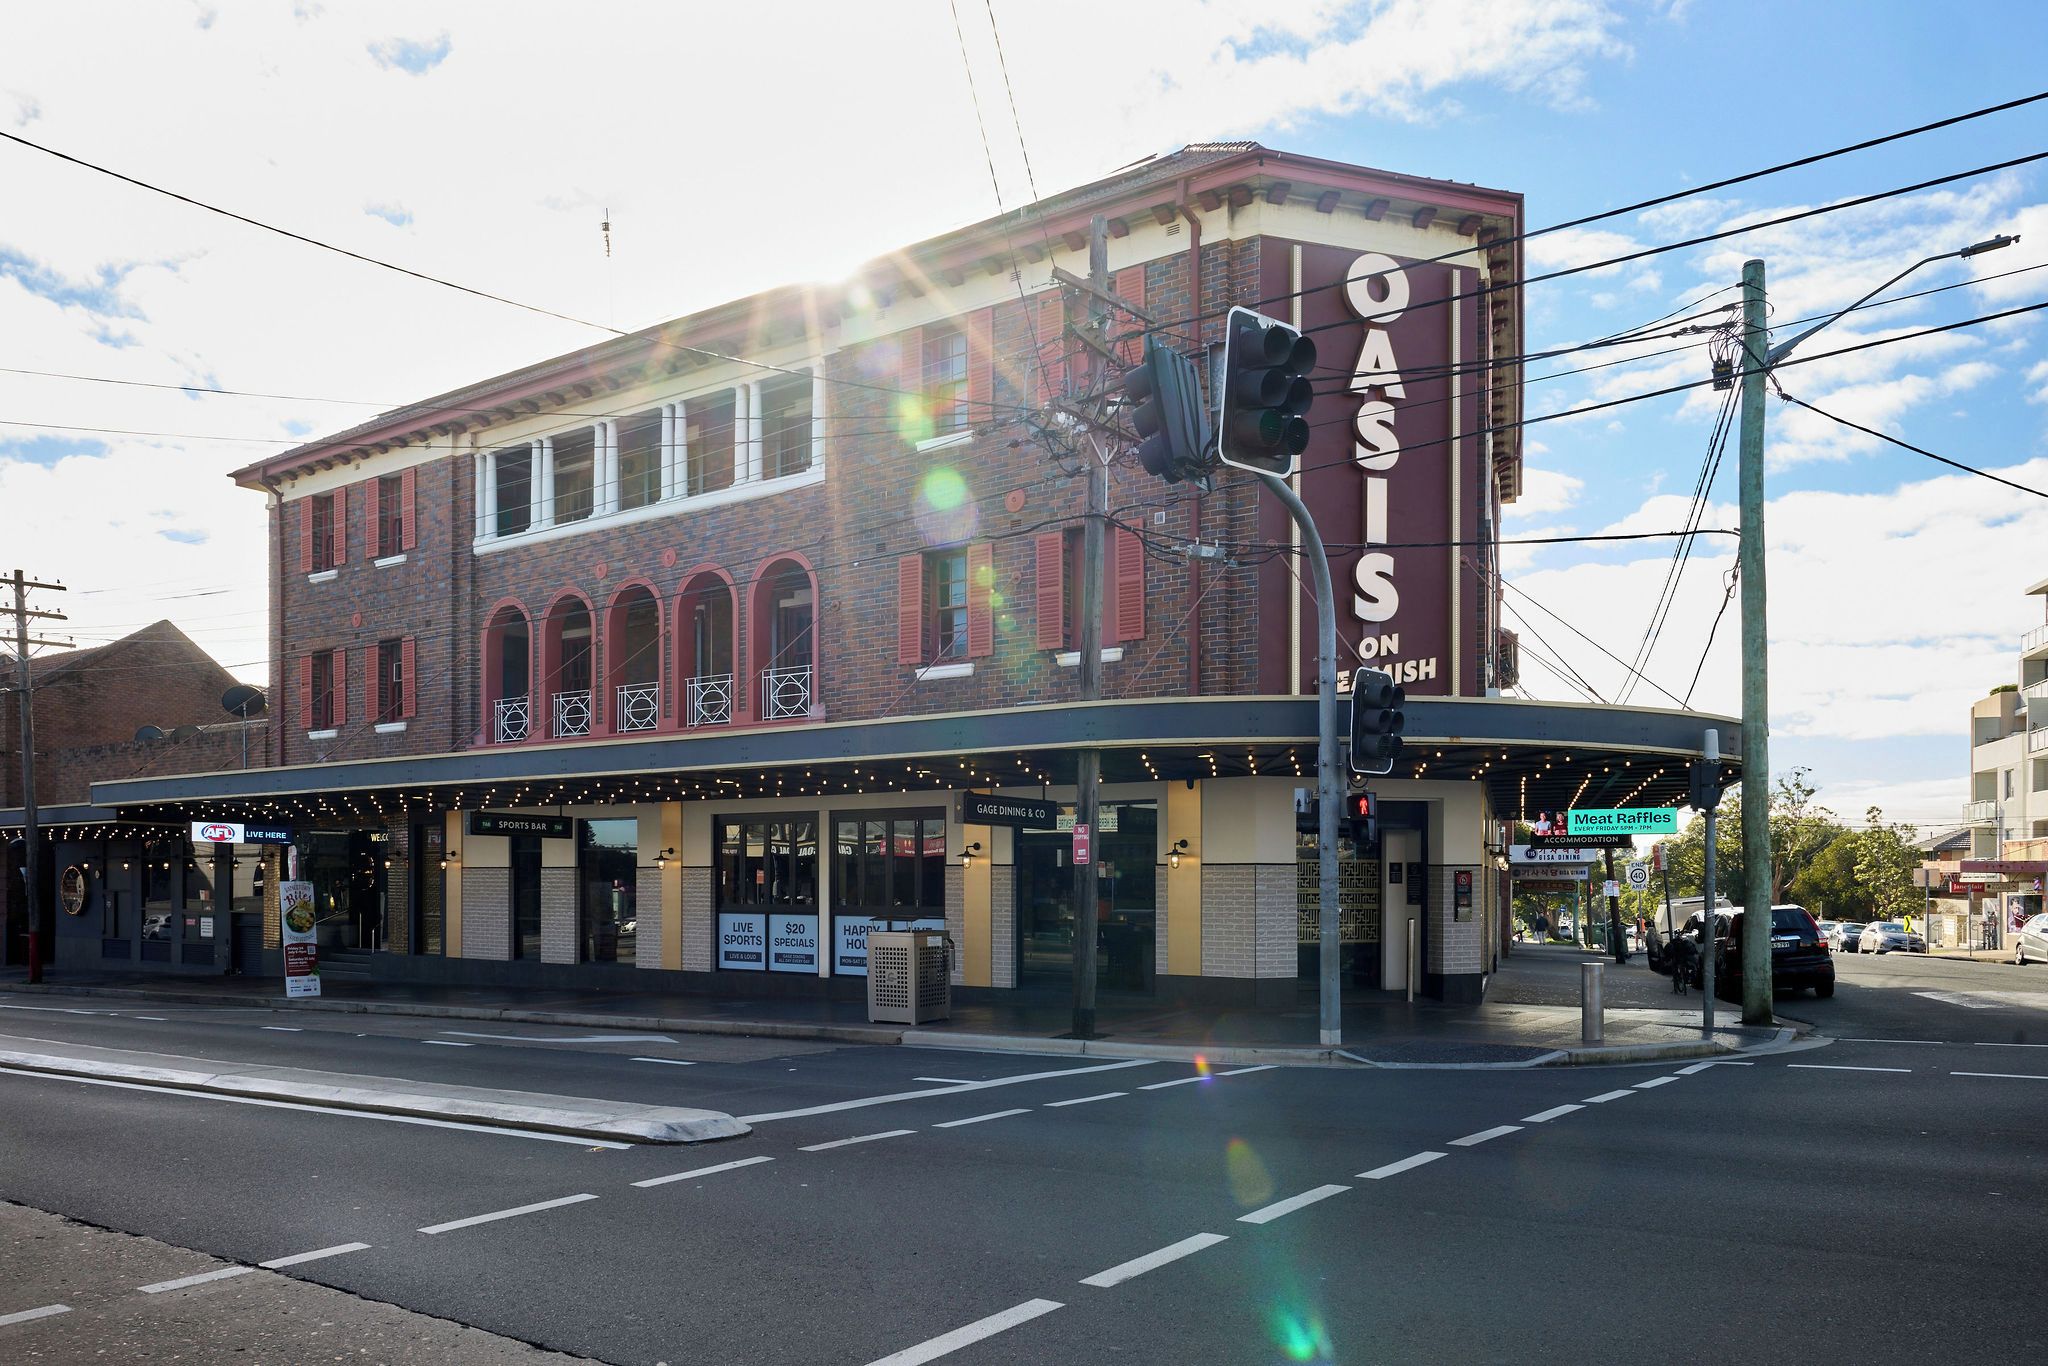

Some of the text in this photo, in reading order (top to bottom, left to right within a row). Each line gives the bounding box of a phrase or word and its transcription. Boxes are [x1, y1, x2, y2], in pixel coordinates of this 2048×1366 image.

[1343, 252, 1410, 623] OASIS
[1358, 633, 1400, 660] ON
[1336, 657, 1437, 694] EMISH
[977, 804, 1046, 819] GAGE DINING & CO
[1574, 811, 1671, 825] Meat Raffles
[498, 820, 547, 831] SPORTS BAR
[203, 827, 233, 840] AFL
[246, 831, 287, 839] LIVE HERE
[1544, 836, 1619, 844] ACCOMMODATION
[1633, 872, 1644, 880] 40
[732, 922, 754, 933] LIVE
[785, 921, 806, 936] $20
[843, 924, 881, 936] HAPPY
[723, 934, 763, 946] SPORTS
[774, 937, 815, 948] SPECIALS
[846, 938, 868, 950] HOU
